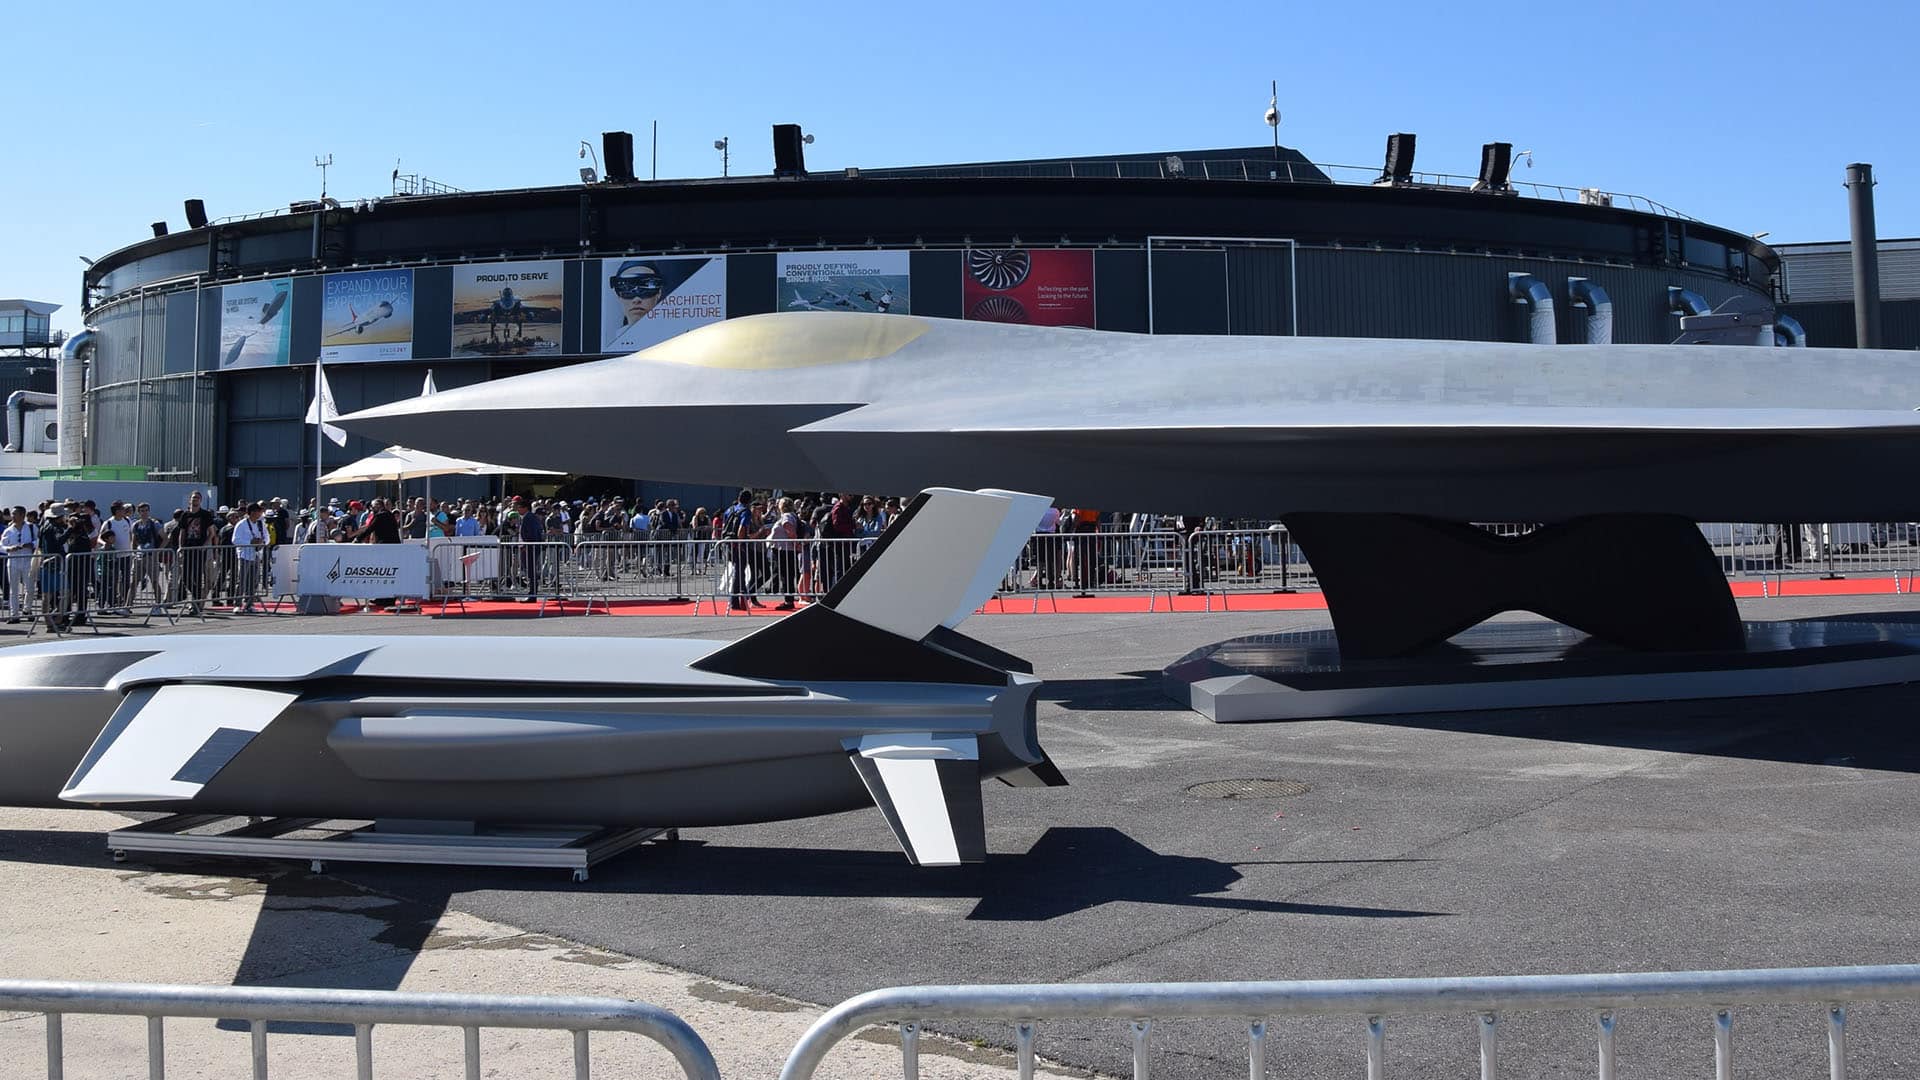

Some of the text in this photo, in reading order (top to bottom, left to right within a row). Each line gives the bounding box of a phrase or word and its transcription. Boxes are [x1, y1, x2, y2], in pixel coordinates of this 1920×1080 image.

[476, 274, 506, 282] PROUD
[520, 272, 549, 281] SERVE
[327, 276, 408, 295] EXPAND YOUR
[327, 292, 409, 311] EXPECTATIONS
[661, 294, 722, 306] ARCHITECT
[647, 307, 721, 319] OF THE FUTURE
[344, 567, 399, 576] DASSAULT
